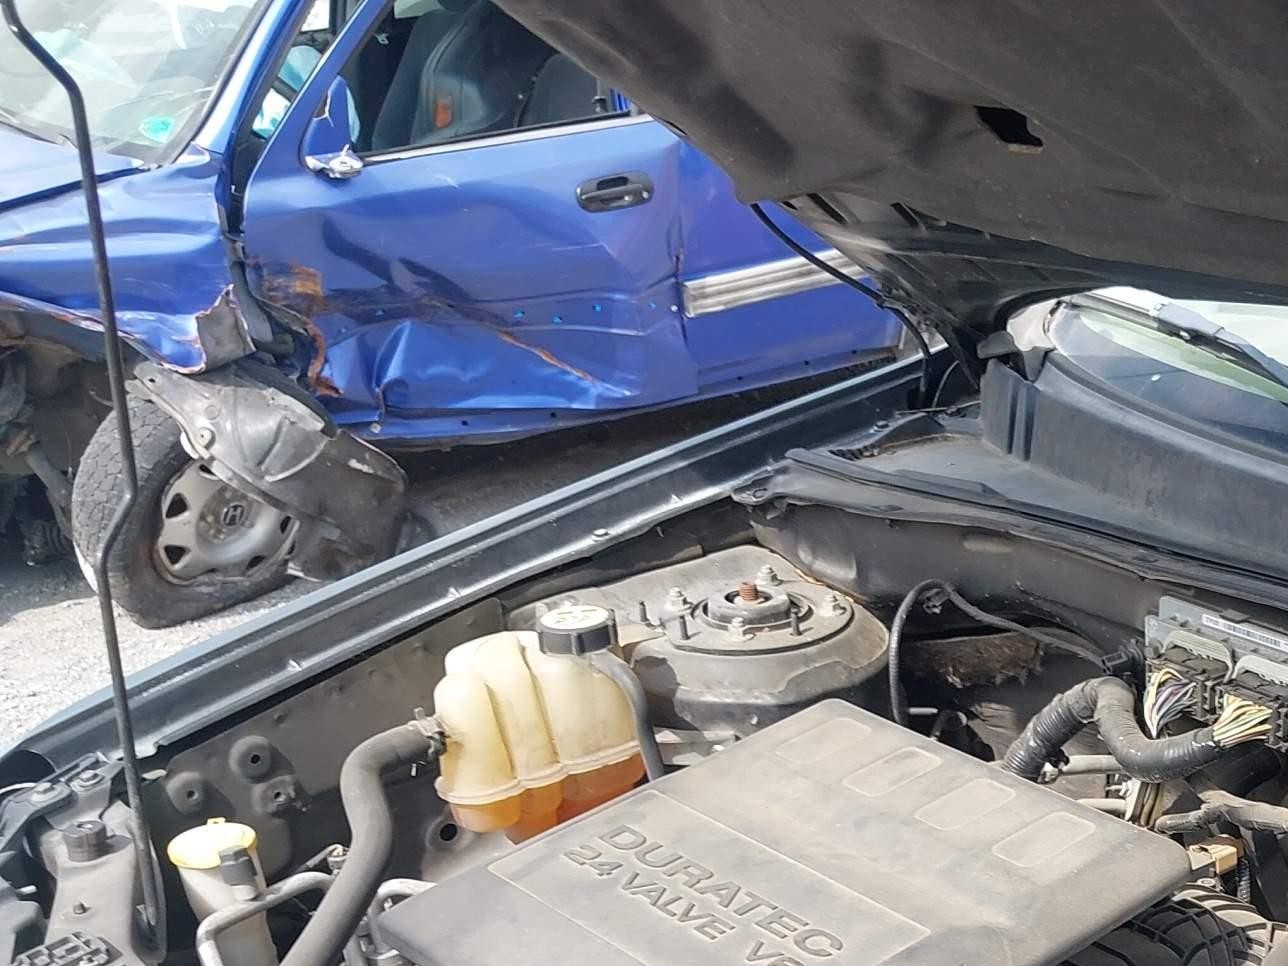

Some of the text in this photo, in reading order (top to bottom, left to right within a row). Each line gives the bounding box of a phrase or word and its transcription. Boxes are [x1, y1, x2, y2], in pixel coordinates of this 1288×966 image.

[563, 845, 624, 877] 24
[621, 871, 737, 941] VALVE
[598, 824, 844, 958] DURATEC
